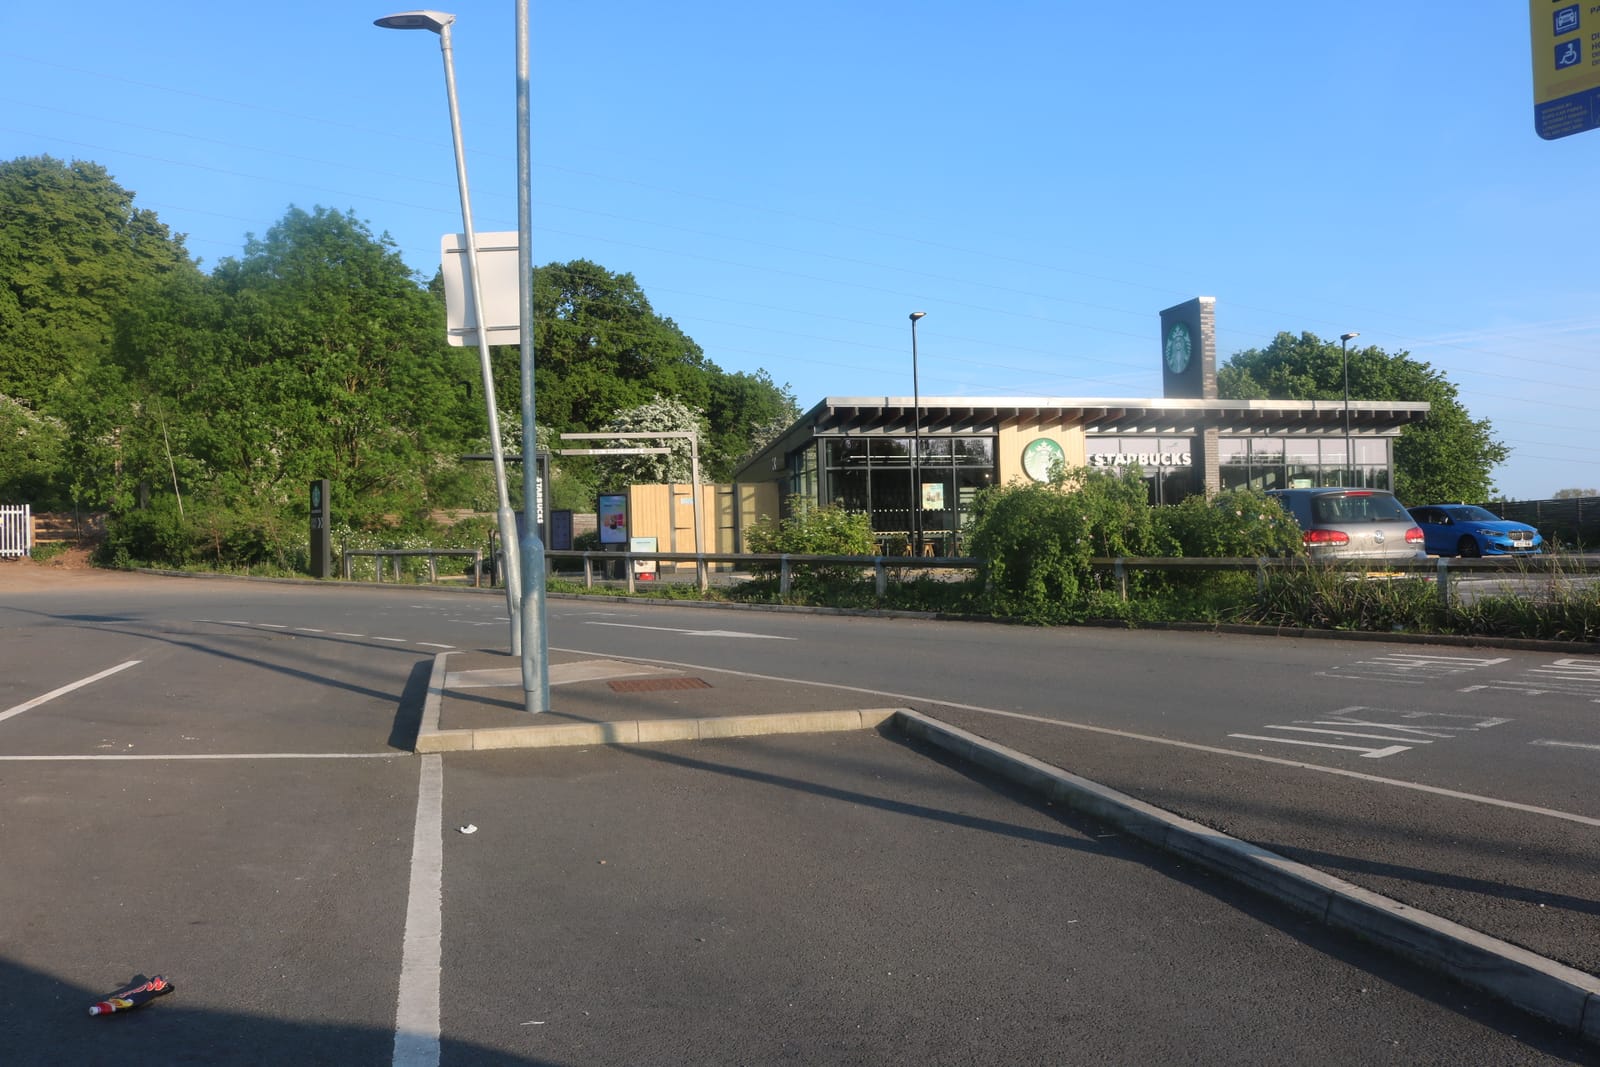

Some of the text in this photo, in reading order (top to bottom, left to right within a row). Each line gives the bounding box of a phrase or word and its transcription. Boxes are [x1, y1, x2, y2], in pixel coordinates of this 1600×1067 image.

[1094, 452, 1192, 466] STARBUCKS
[535, 476, 544, 524] STARBUCKS
[1227, 705, 1517, 758] EXIT
